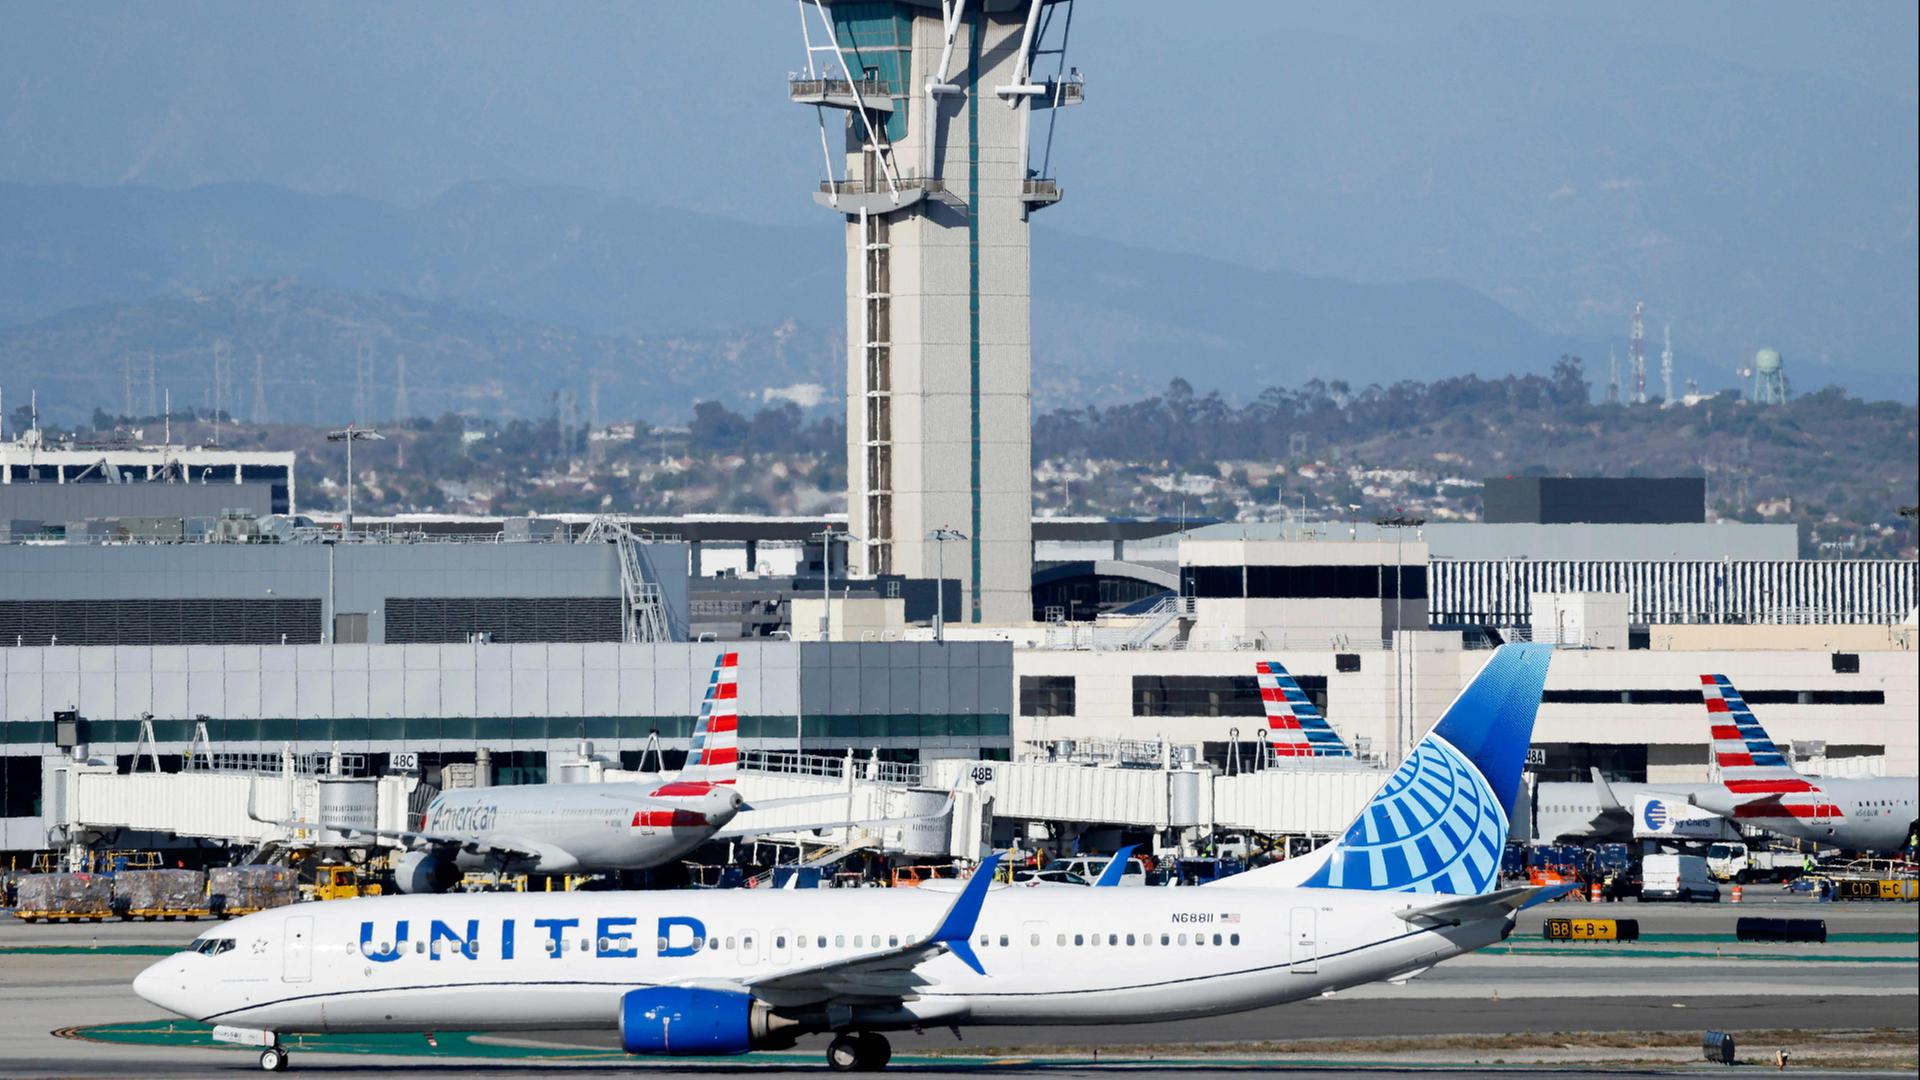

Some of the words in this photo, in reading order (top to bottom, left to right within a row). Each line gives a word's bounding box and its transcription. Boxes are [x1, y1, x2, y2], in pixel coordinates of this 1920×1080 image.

[393, 754, 414, 768] 48C
[1526, 750, 1543, 763] 48A
[971, 767, 992, 781] 48B
[431, 800, 497, 832] American
[1852, 883, 1871, 895] C10
[1892, 883, 1900, 895] C
[1171, 912, 1214, 923] N68811
[1552, 922, 1569, 936] B8
[1587, 923, 1595, 936] B
[360, 916, 707, 963] UNITED
